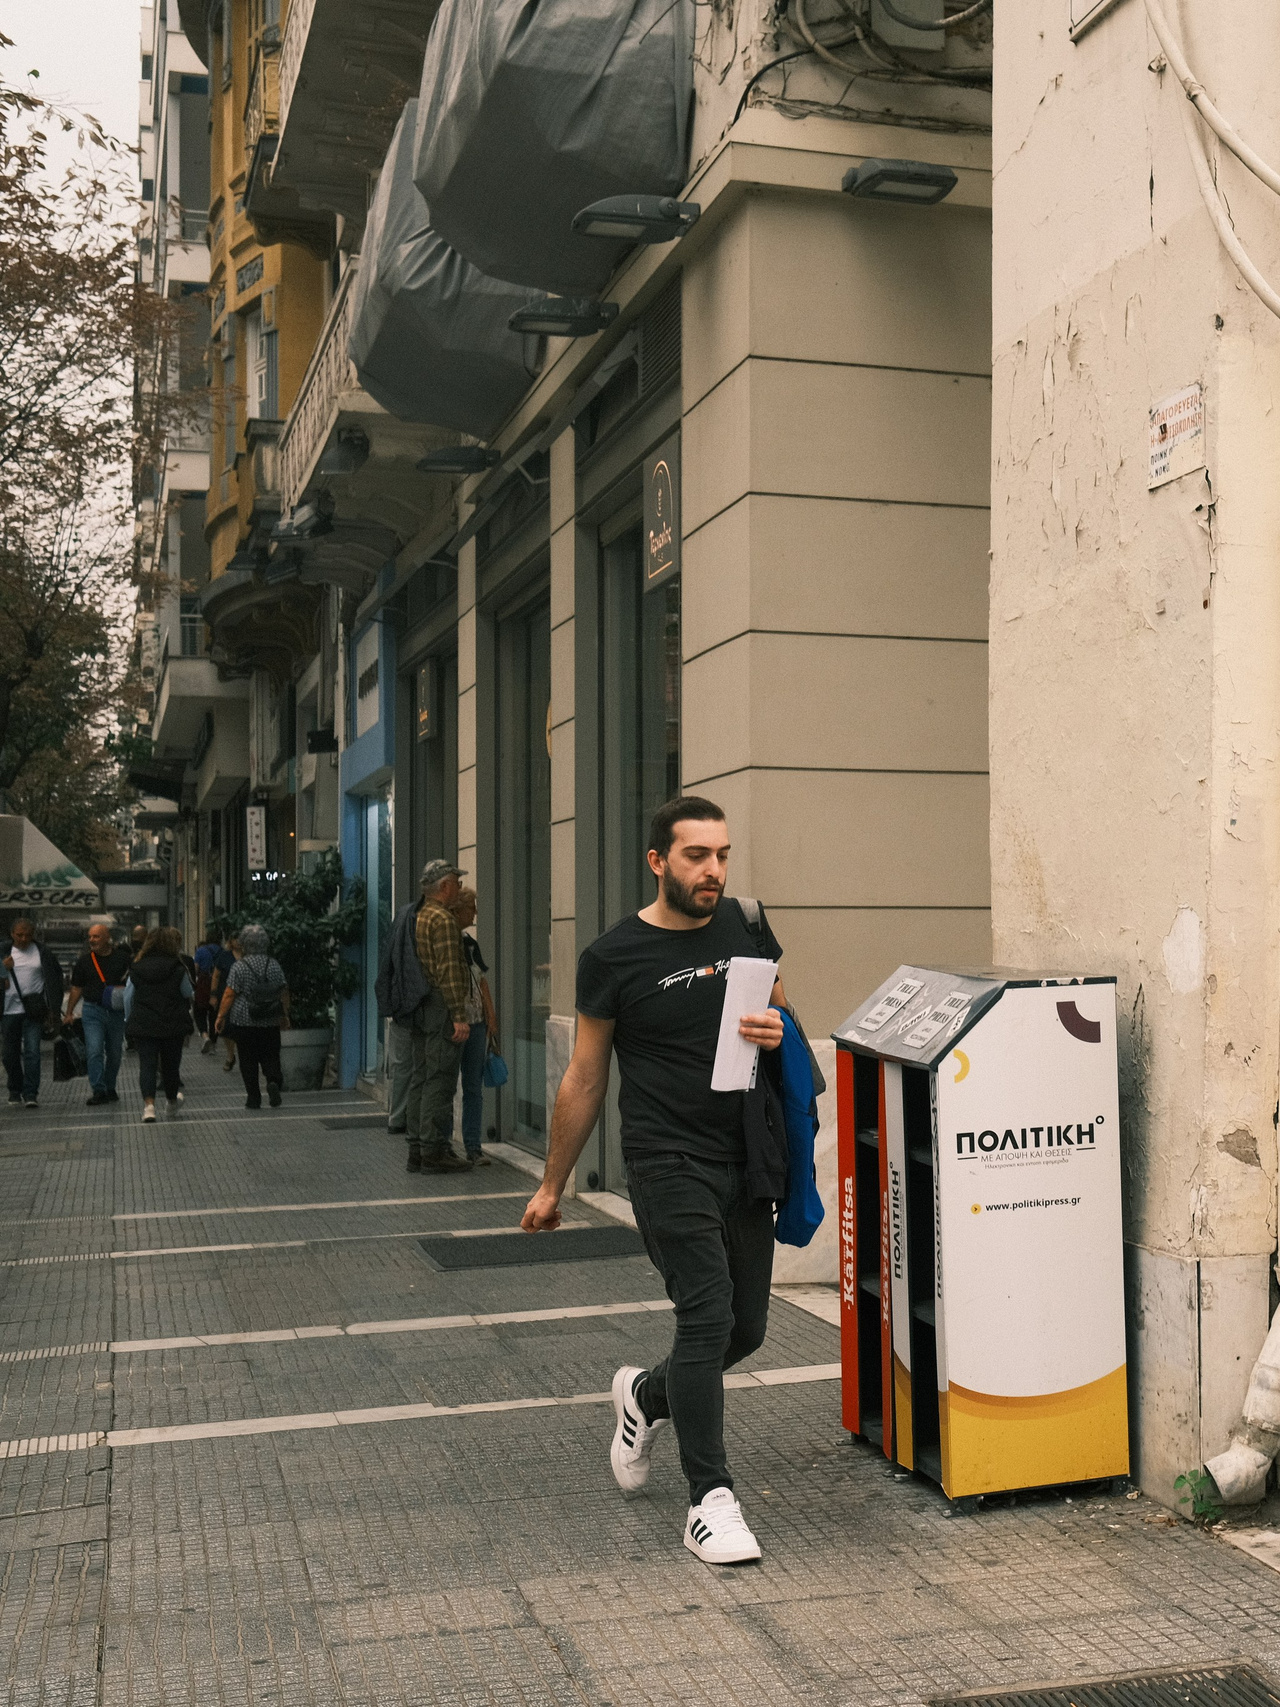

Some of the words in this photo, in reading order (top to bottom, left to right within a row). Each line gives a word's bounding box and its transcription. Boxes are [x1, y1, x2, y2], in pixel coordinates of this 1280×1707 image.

[658, 967, 695, 991] Tommy
[896, 982, 917, 995] FREE
[881, 996, 905, 1009] PRESS
[943, 996, 966, 1009] FREE
[927, 1010, 952, 1023] PRESS
[980, 1154, 994, 1163] ΜΕ
[995, 1151, 1028, 1162] ΑΠΟΨΗ
[1030, 1150, 1043, 1159] ΚΑΙ
[1045, 1147, 1073, 1158] ΘΕΣΕΙΣ
[985, 1196, 1082, 1212] www.politikipress.gr
[842, 1176, 854, 1306] Karfitsa
